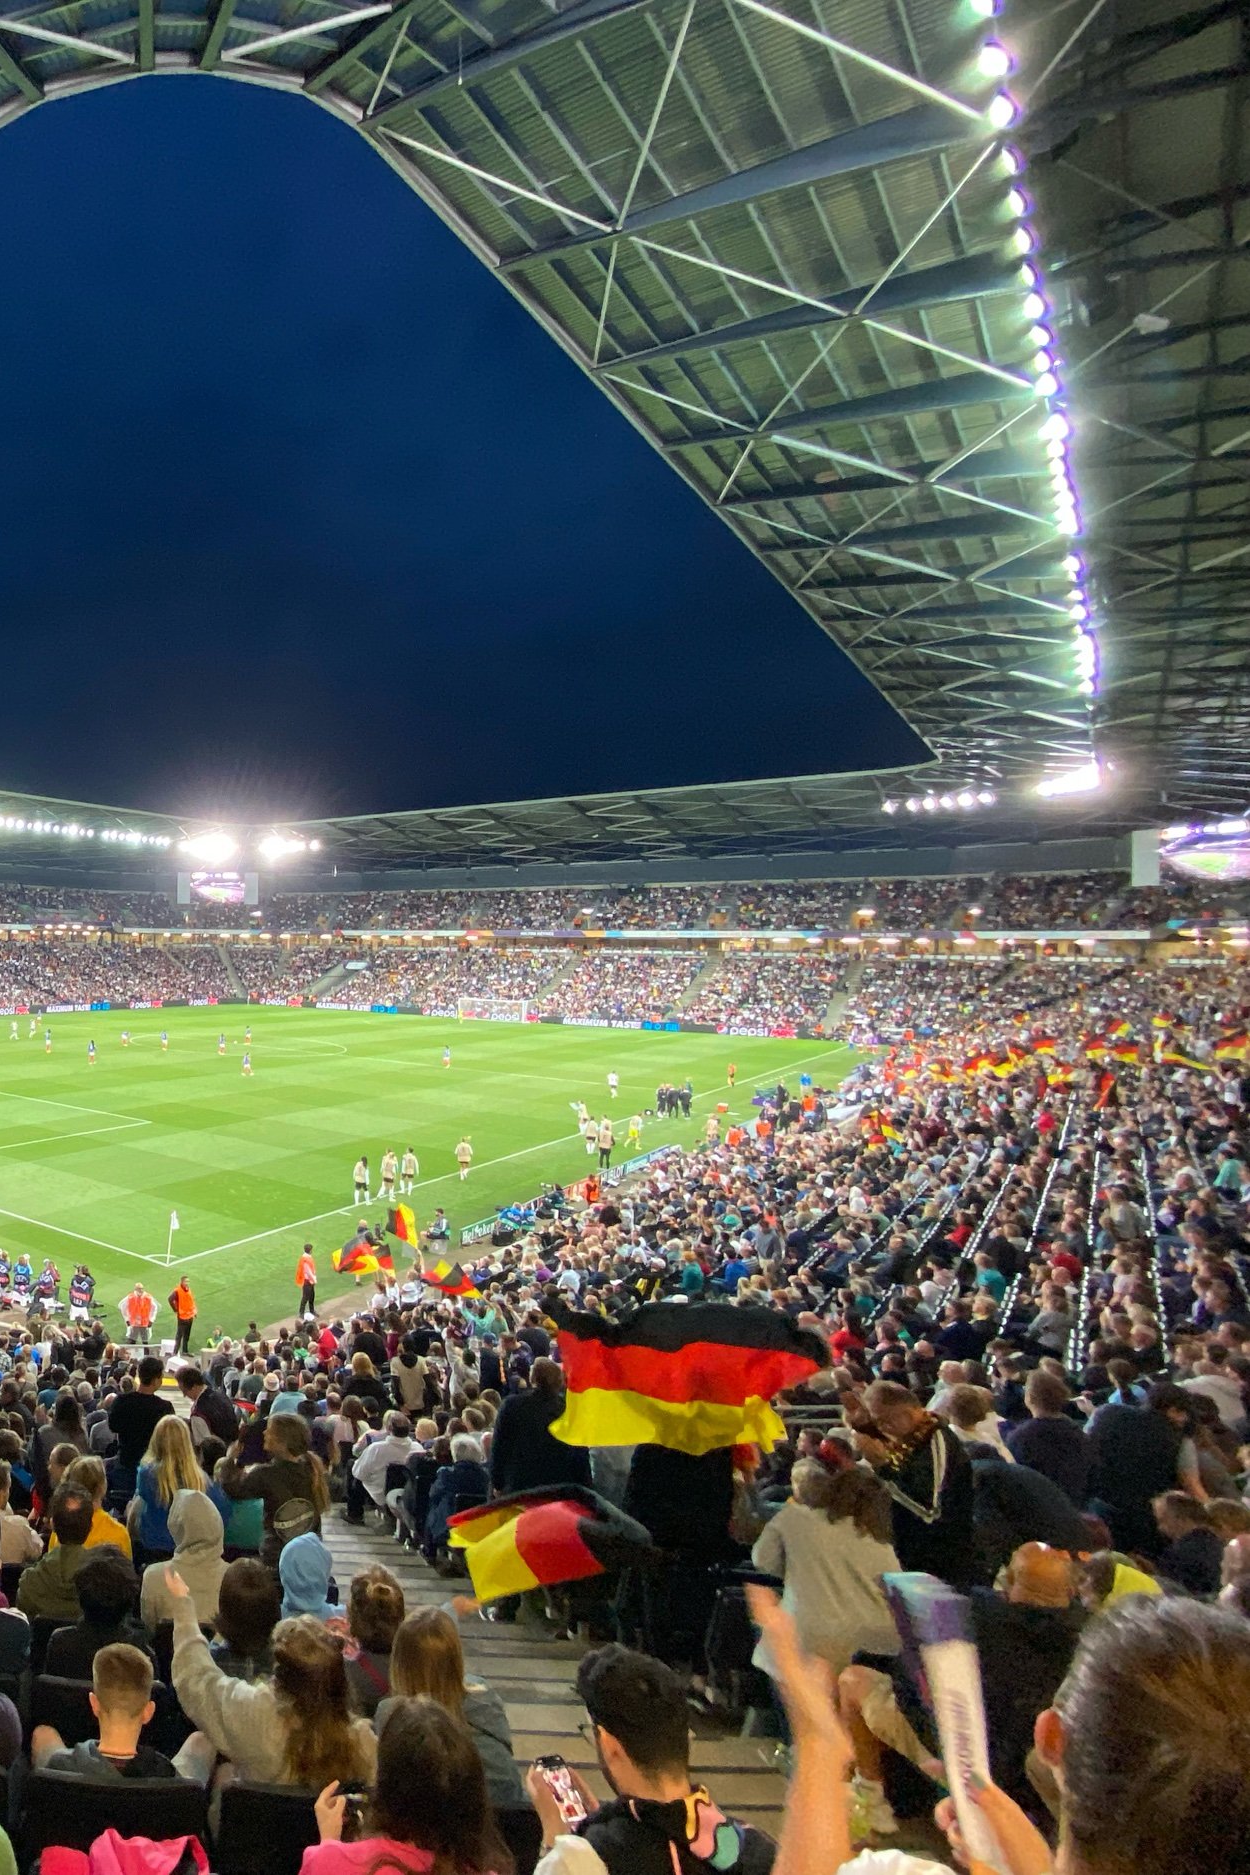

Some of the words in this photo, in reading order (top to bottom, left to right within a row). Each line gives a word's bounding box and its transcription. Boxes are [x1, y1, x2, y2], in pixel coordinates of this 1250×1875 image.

[431, 1009, 458, 1019] pepsi
[563, 1017, 608, 1027] MAXIMUM
[730, 1026, 768, 1037] pepsi
